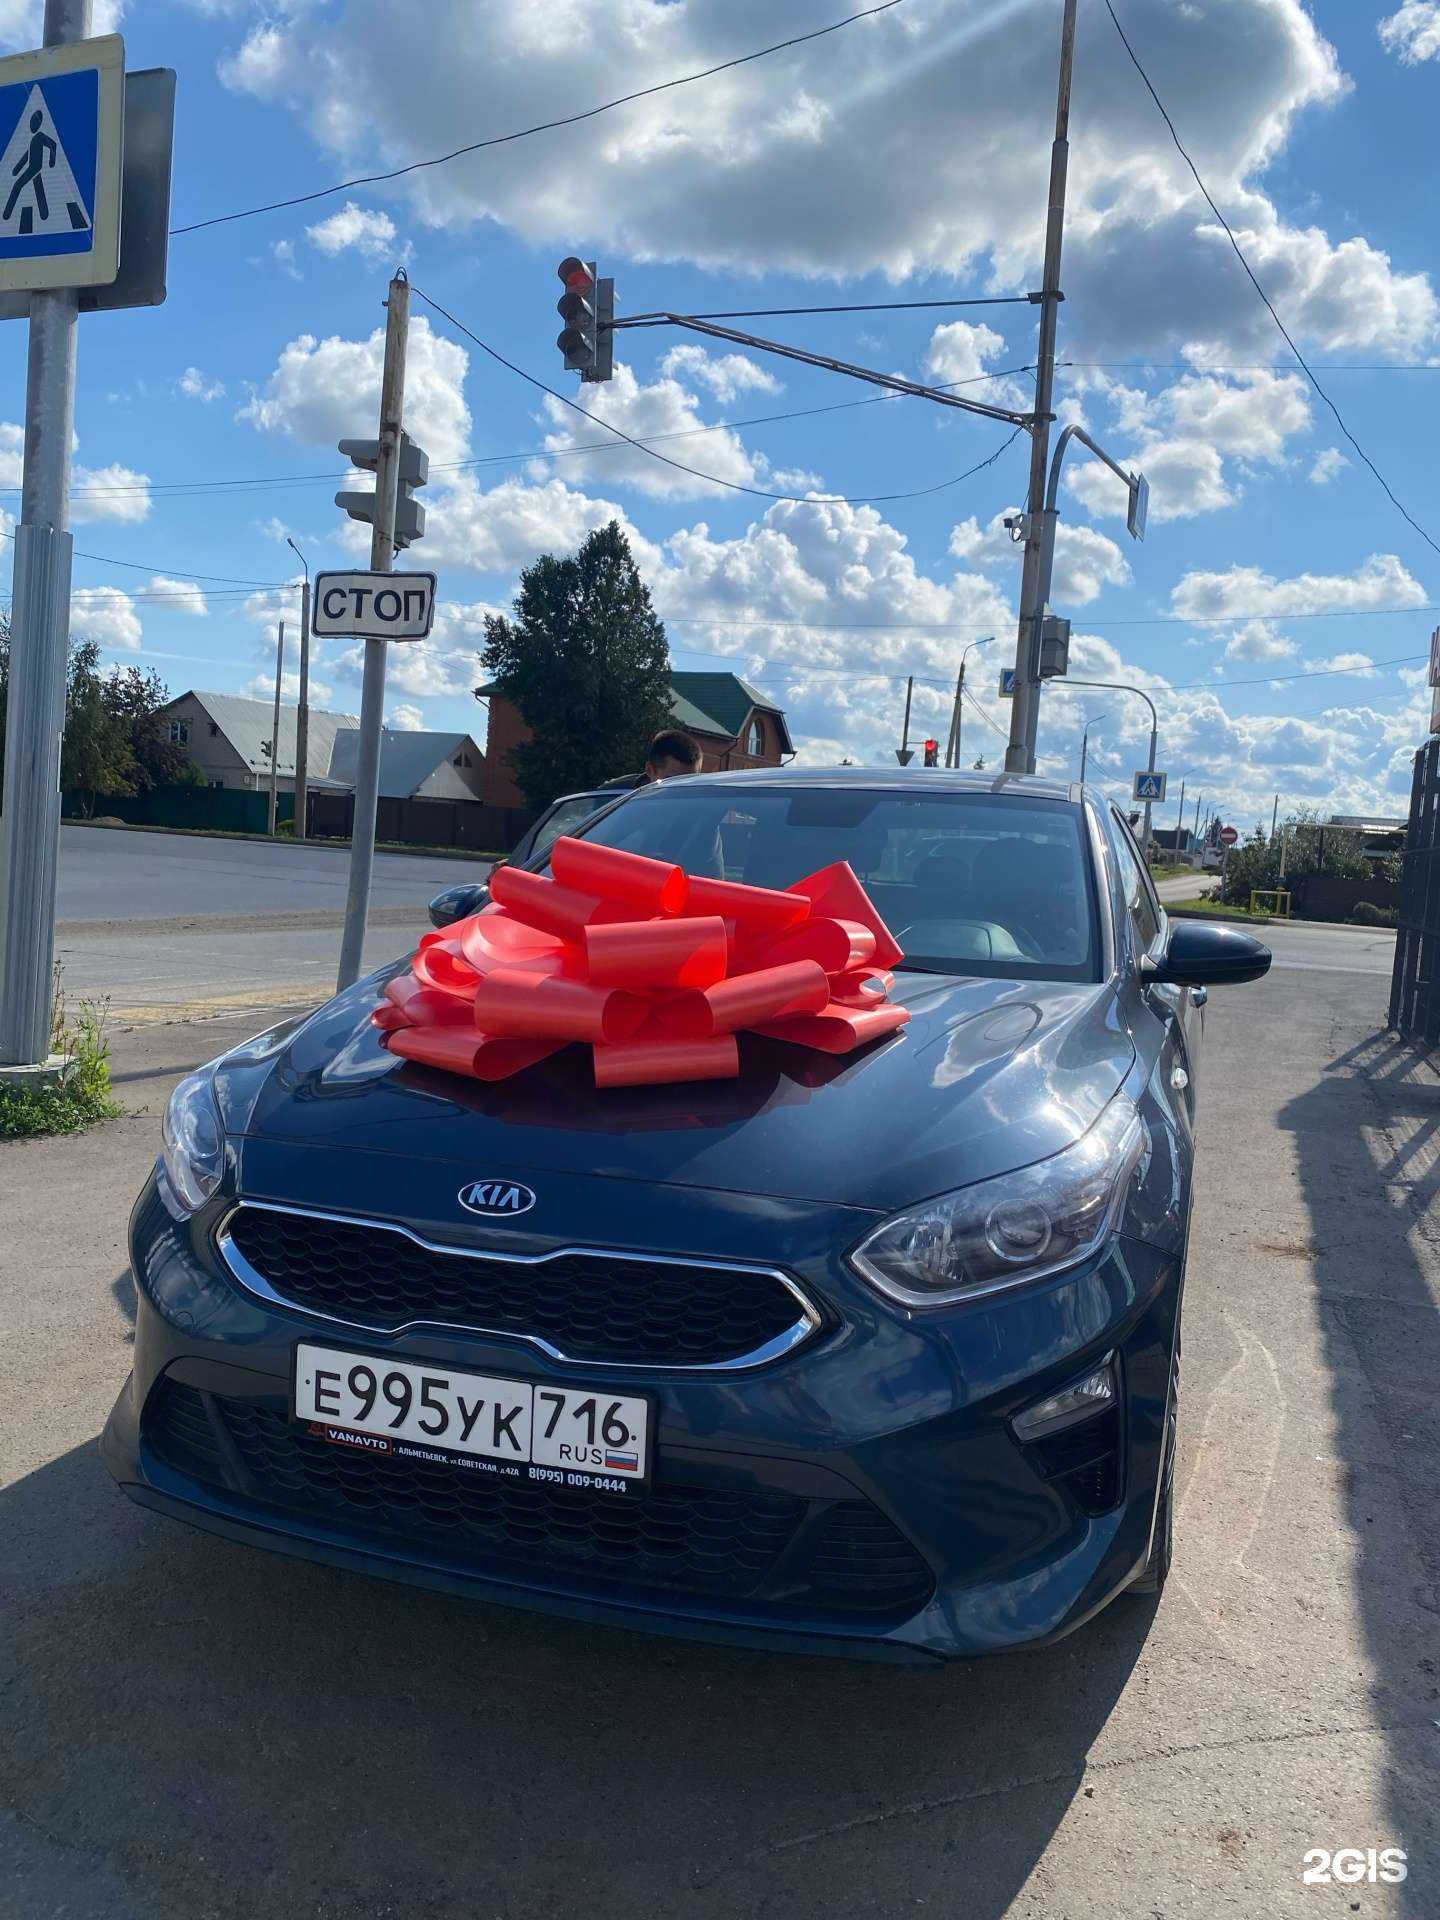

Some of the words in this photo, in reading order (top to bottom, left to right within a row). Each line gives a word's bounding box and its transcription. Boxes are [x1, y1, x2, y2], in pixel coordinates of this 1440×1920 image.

[323, 588, 425, 621] СТОП
[468, 1184, 519, 1209] KIA
[540, 1392, 629, 1448] 716
[328, 1429, 388, 1450] VANAVTO
[560, 1444, 602, 1465] RUS
[528, 1467, 564, 1484] 8(995)
[567, 1473, 627, 1492] 009-0444
